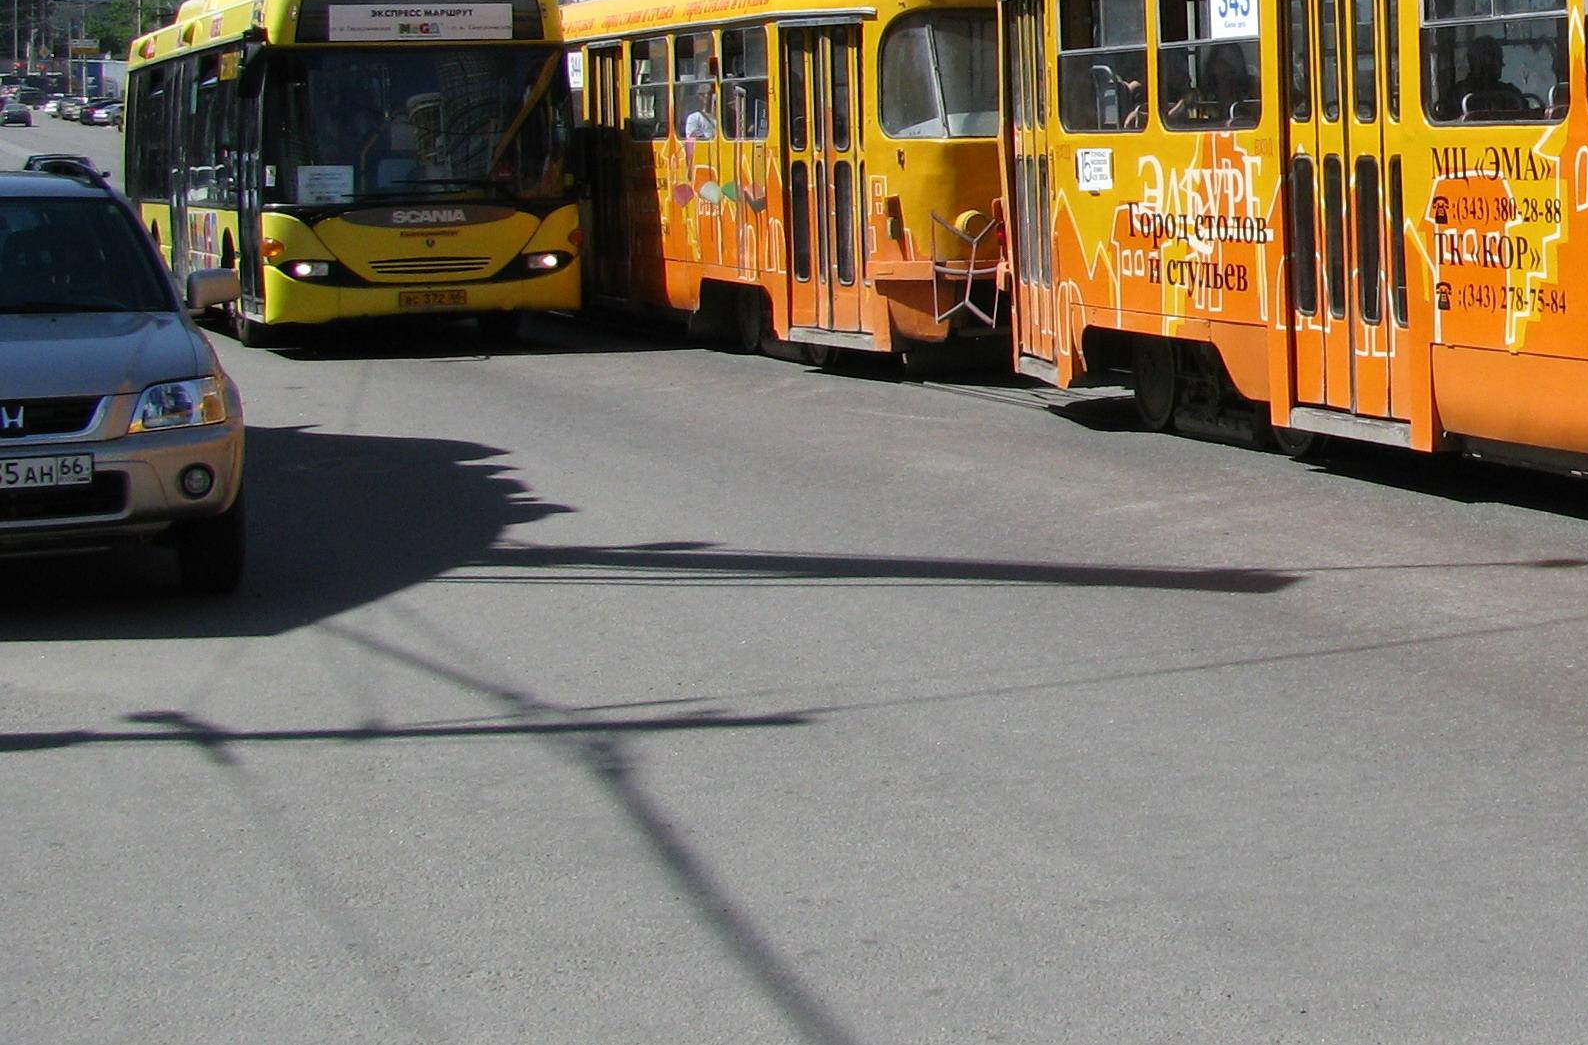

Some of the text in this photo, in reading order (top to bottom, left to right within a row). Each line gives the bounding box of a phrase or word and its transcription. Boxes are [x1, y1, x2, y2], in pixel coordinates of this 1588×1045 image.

[371, 9, 473, 18] ЭКСПРЕСС МАРШРУТ
[1431, 146, 1552, 187] МЦ «ЭМА»
[392, 209, 467, 224] SCANIA
[1127, 202, 1268, 247] Город столов
[1494, 198, 1562, 224] 380-28-88
[1434, 232, 1541, 270] ТК «КОР»
[1148, 257, 1249, 297] и стульев
[1500, 286, 1567, 315] 278-75-84
[60, 458, 83, 475] 66
